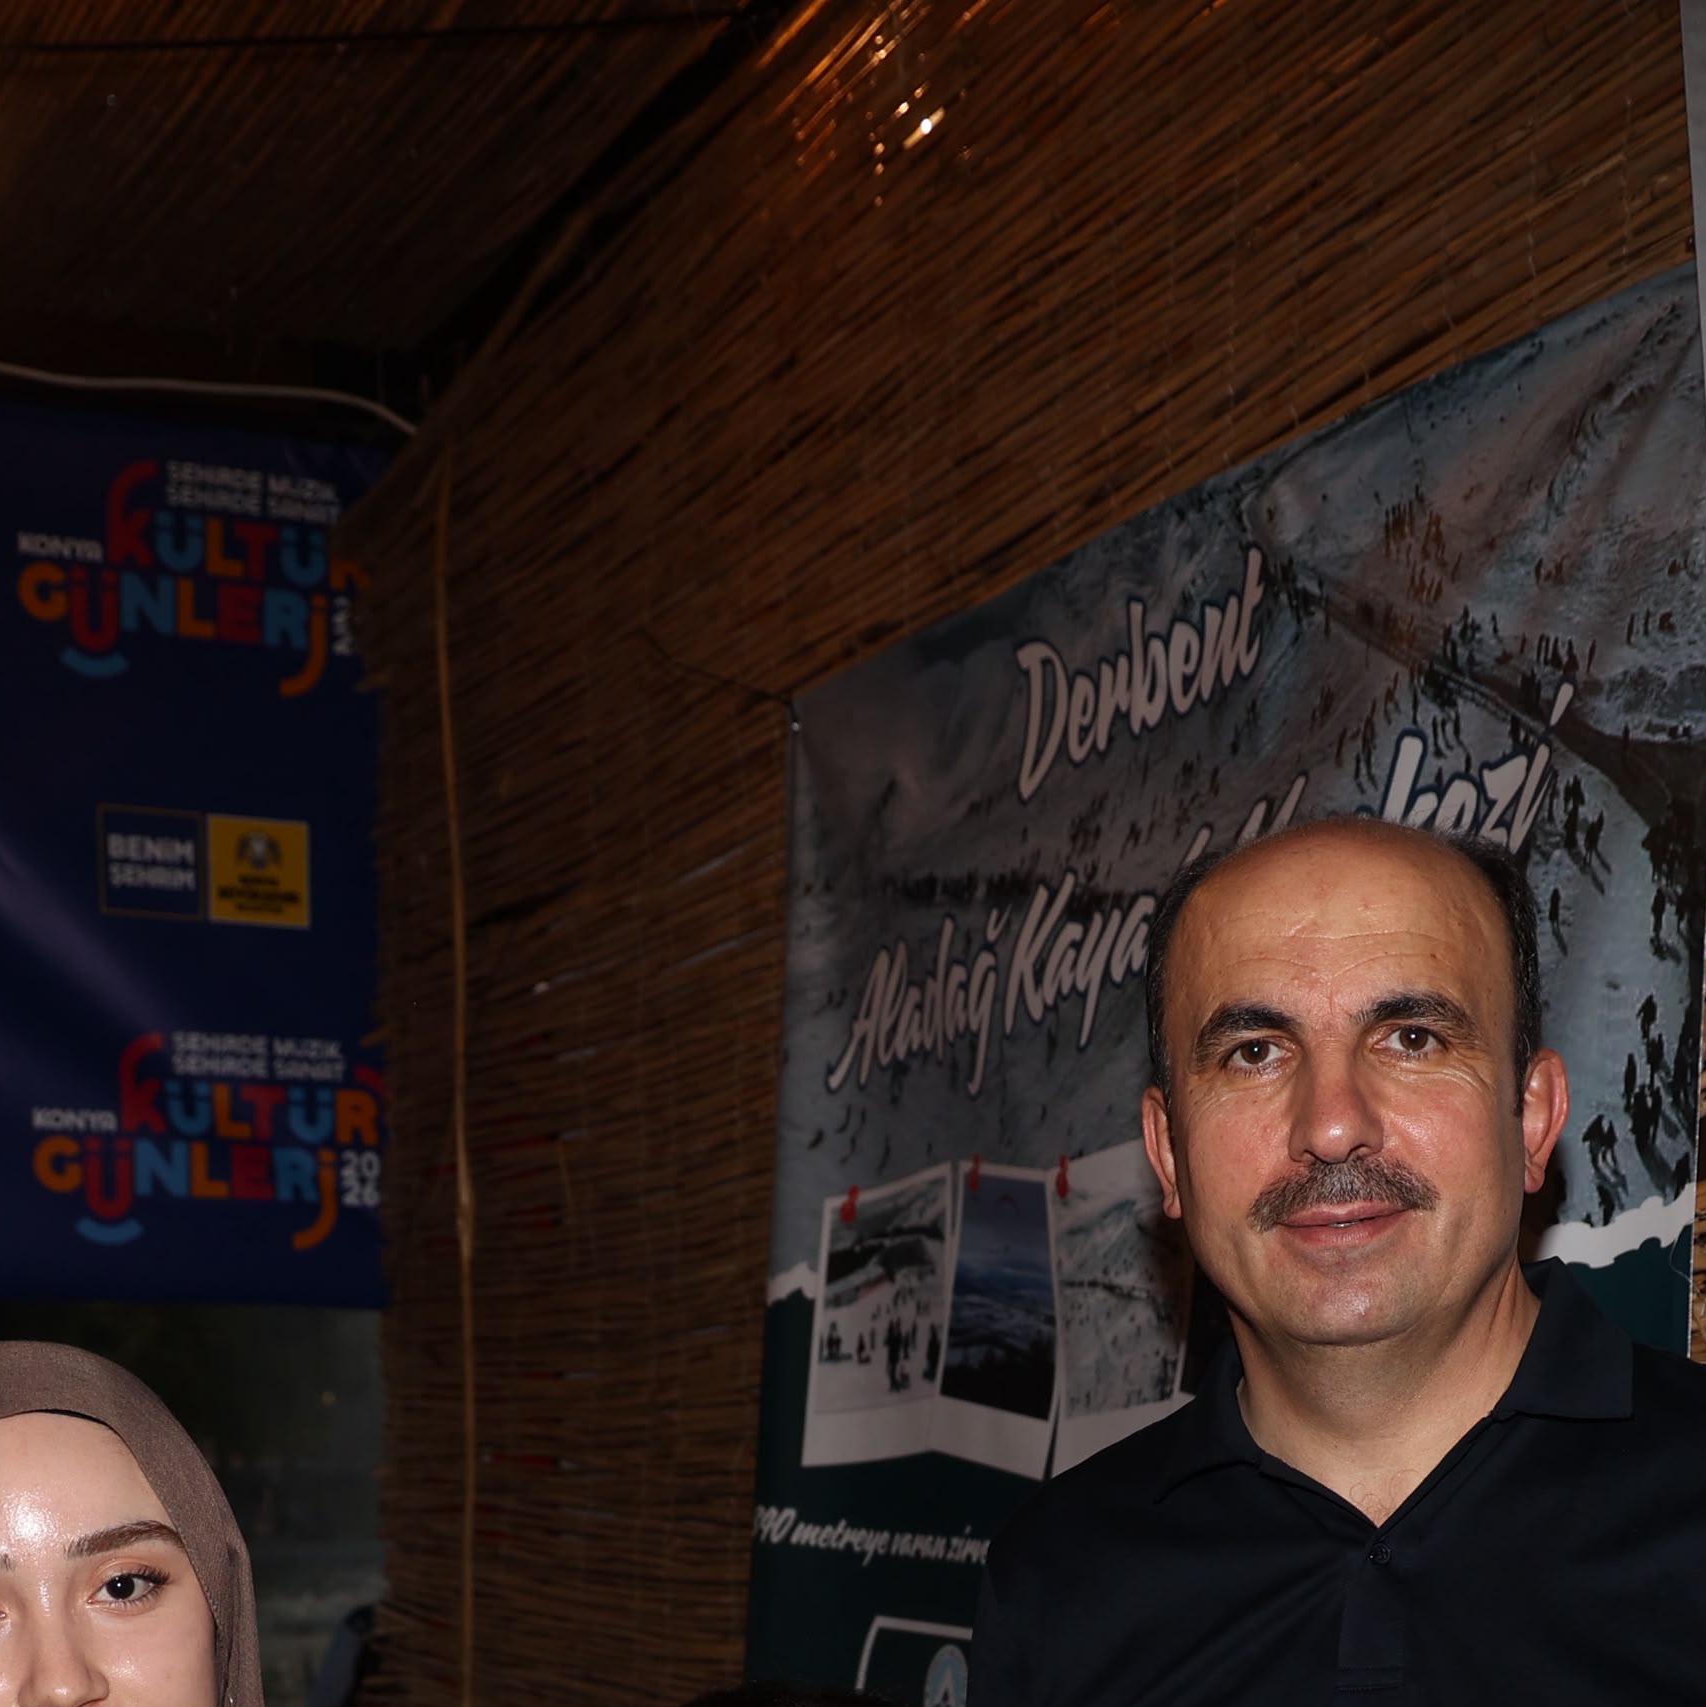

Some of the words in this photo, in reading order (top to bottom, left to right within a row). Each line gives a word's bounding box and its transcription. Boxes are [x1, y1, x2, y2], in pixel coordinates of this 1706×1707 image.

[1016, 546, 1264, 800] Derbent
[107, 832, 196, 864] BENİM
[827, 902, 1011, 1097] Aladağ
[31, 1106, 118, 1133] KONYA
[119, 1030, 379, 1147] KÜLTÜR
[790, 1518, 891, 1568] metreye
